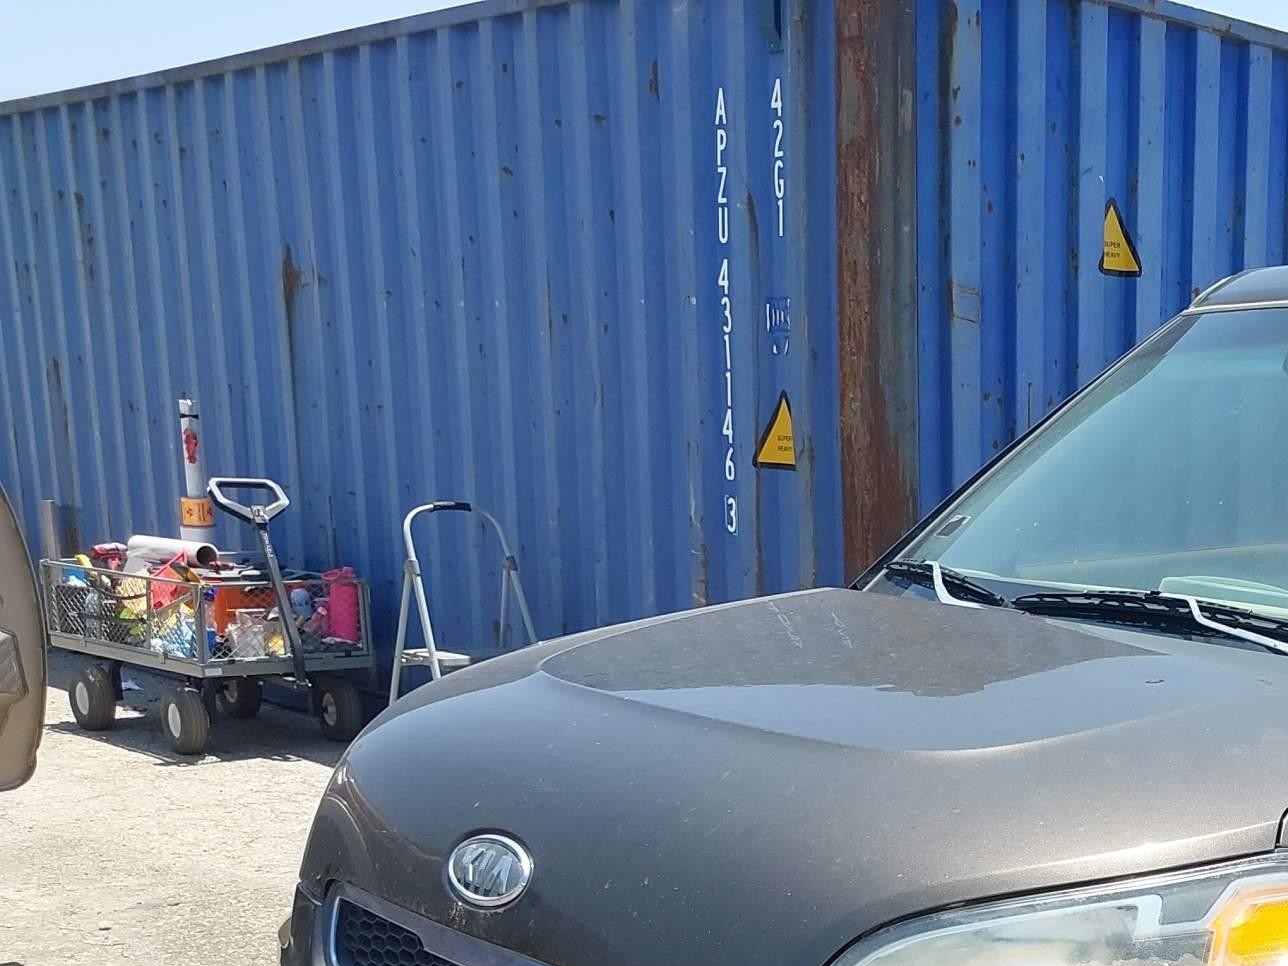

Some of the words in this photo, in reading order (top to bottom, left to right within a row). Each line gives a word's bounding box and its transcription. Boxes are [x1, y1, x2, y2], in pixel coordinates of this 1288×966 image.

[715, 87, 728, 244] APZU
[770, 78, 784, 236] 42G1
[718, 258, 735, 481] 431146
[727, 497, 736, 533] 3
[462, 846, 513, 893] KIA
